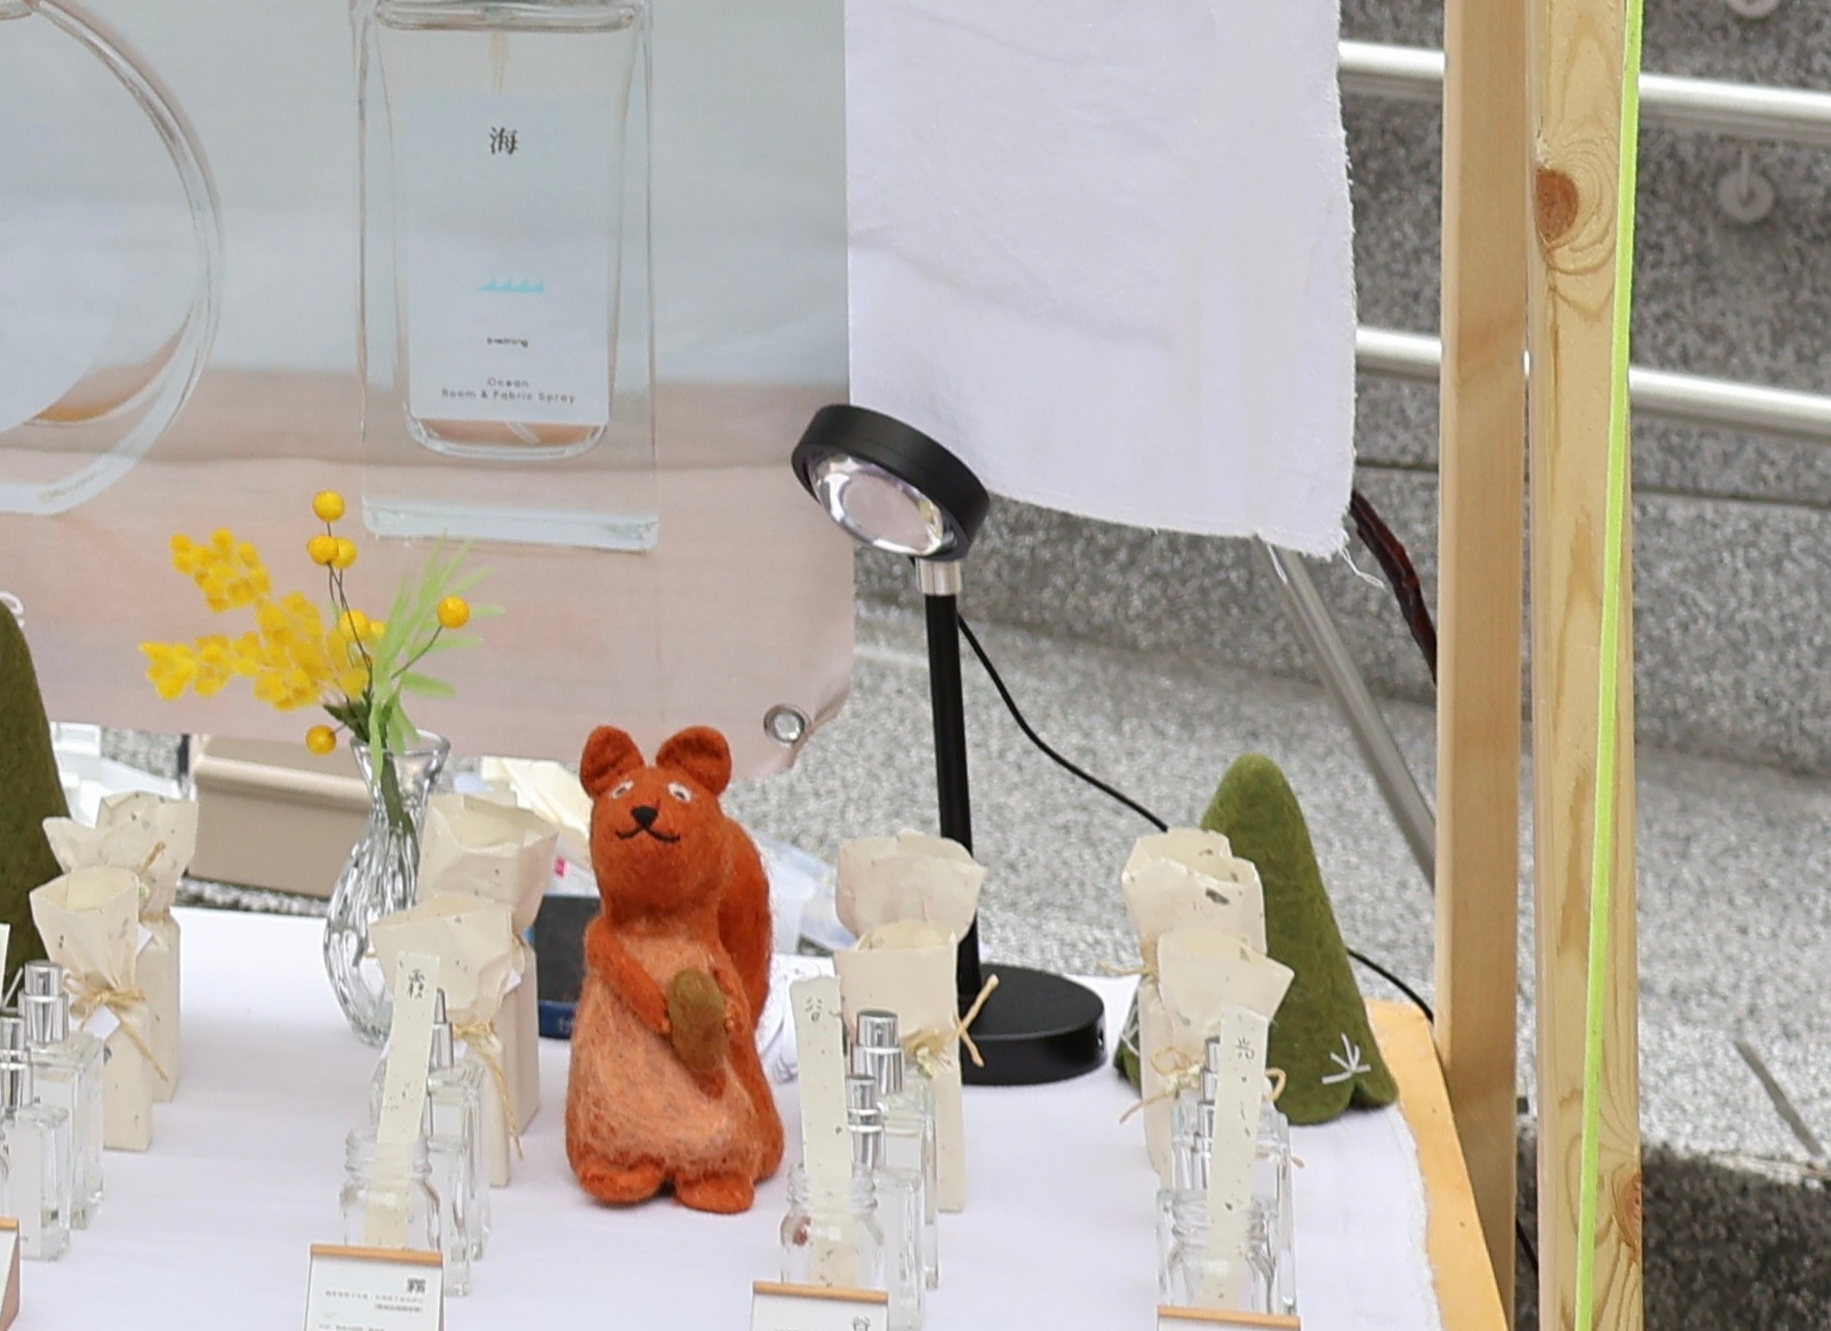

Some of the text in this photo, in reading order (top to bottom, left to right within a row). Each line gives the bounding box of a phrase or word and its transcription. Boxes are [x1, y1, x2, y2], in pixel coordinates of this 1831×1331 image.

[489, 127, 518, 155] 海
[487, 377, 530, 389] Ocean
[492, 389, 534, 402] Fabric
[537, 391, 576, 405] Spray
